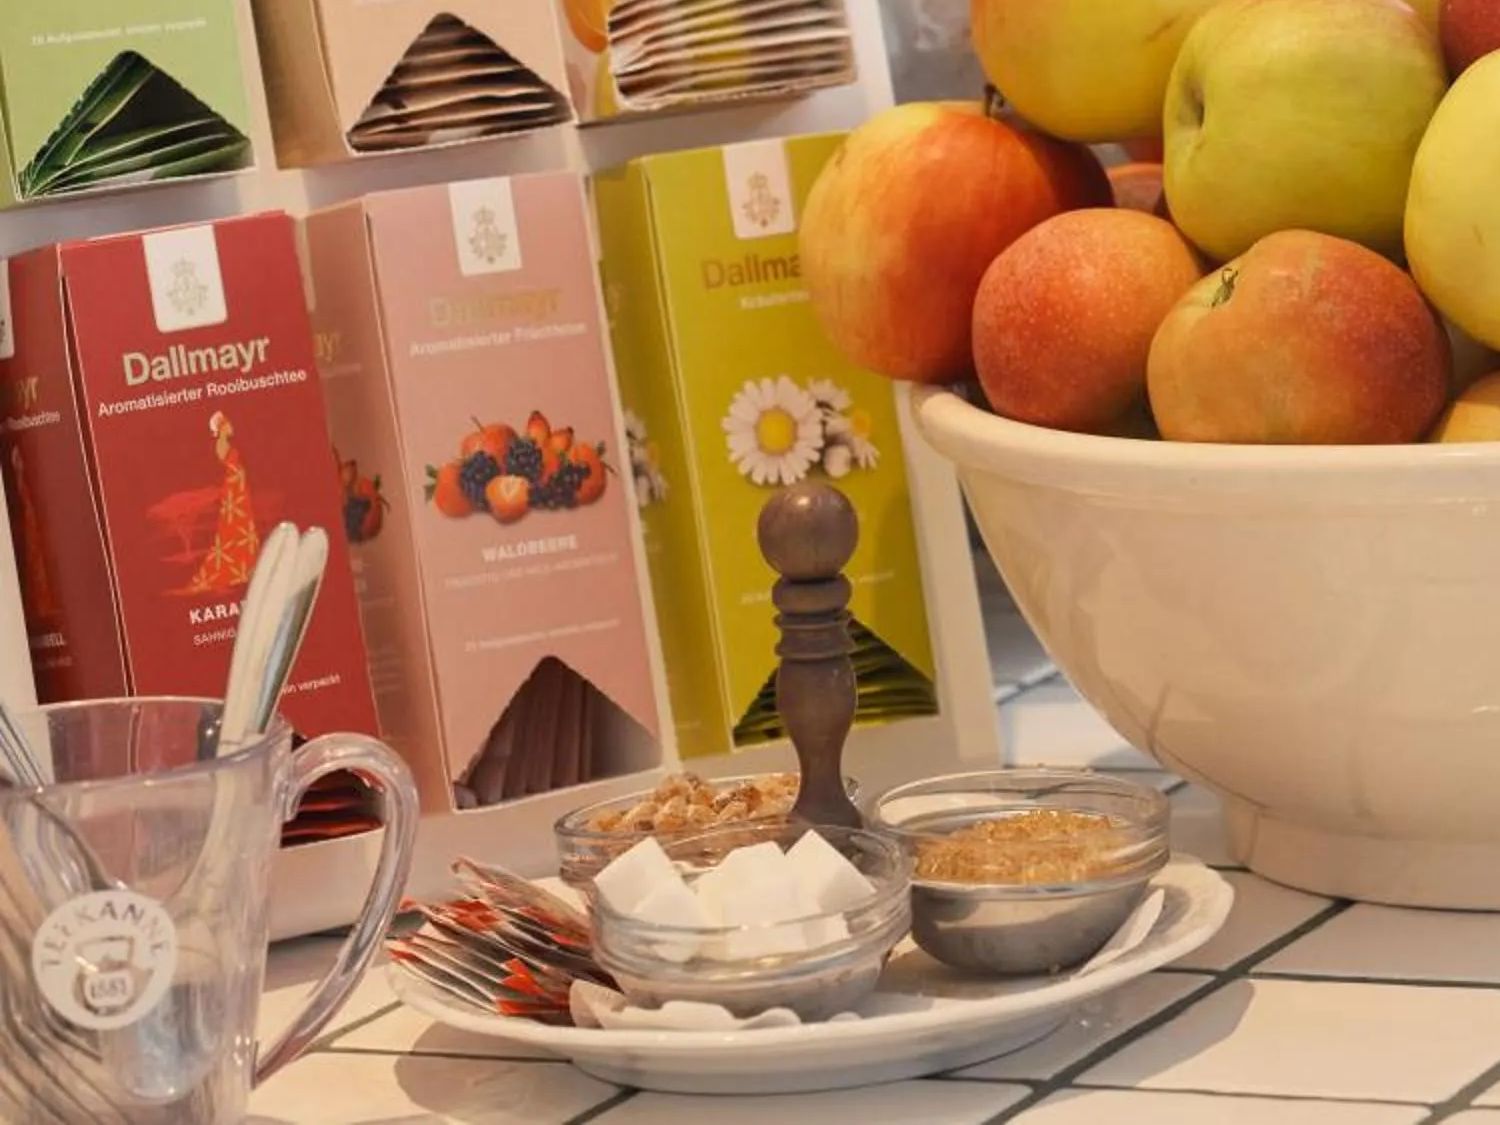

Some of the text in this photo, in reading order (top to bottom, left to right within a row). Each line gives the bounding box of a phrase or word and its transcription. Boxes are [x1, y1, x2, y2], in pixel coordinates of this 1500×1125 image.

[702, 253, 801, 291] Dallma
[122, 335, 270, 387] Dallmayr
[97, 386, 203, 418] Aromatisierter
[206, 368, 307, 398] Rooibuschtee
[188, 601, 243, 625] KARA
